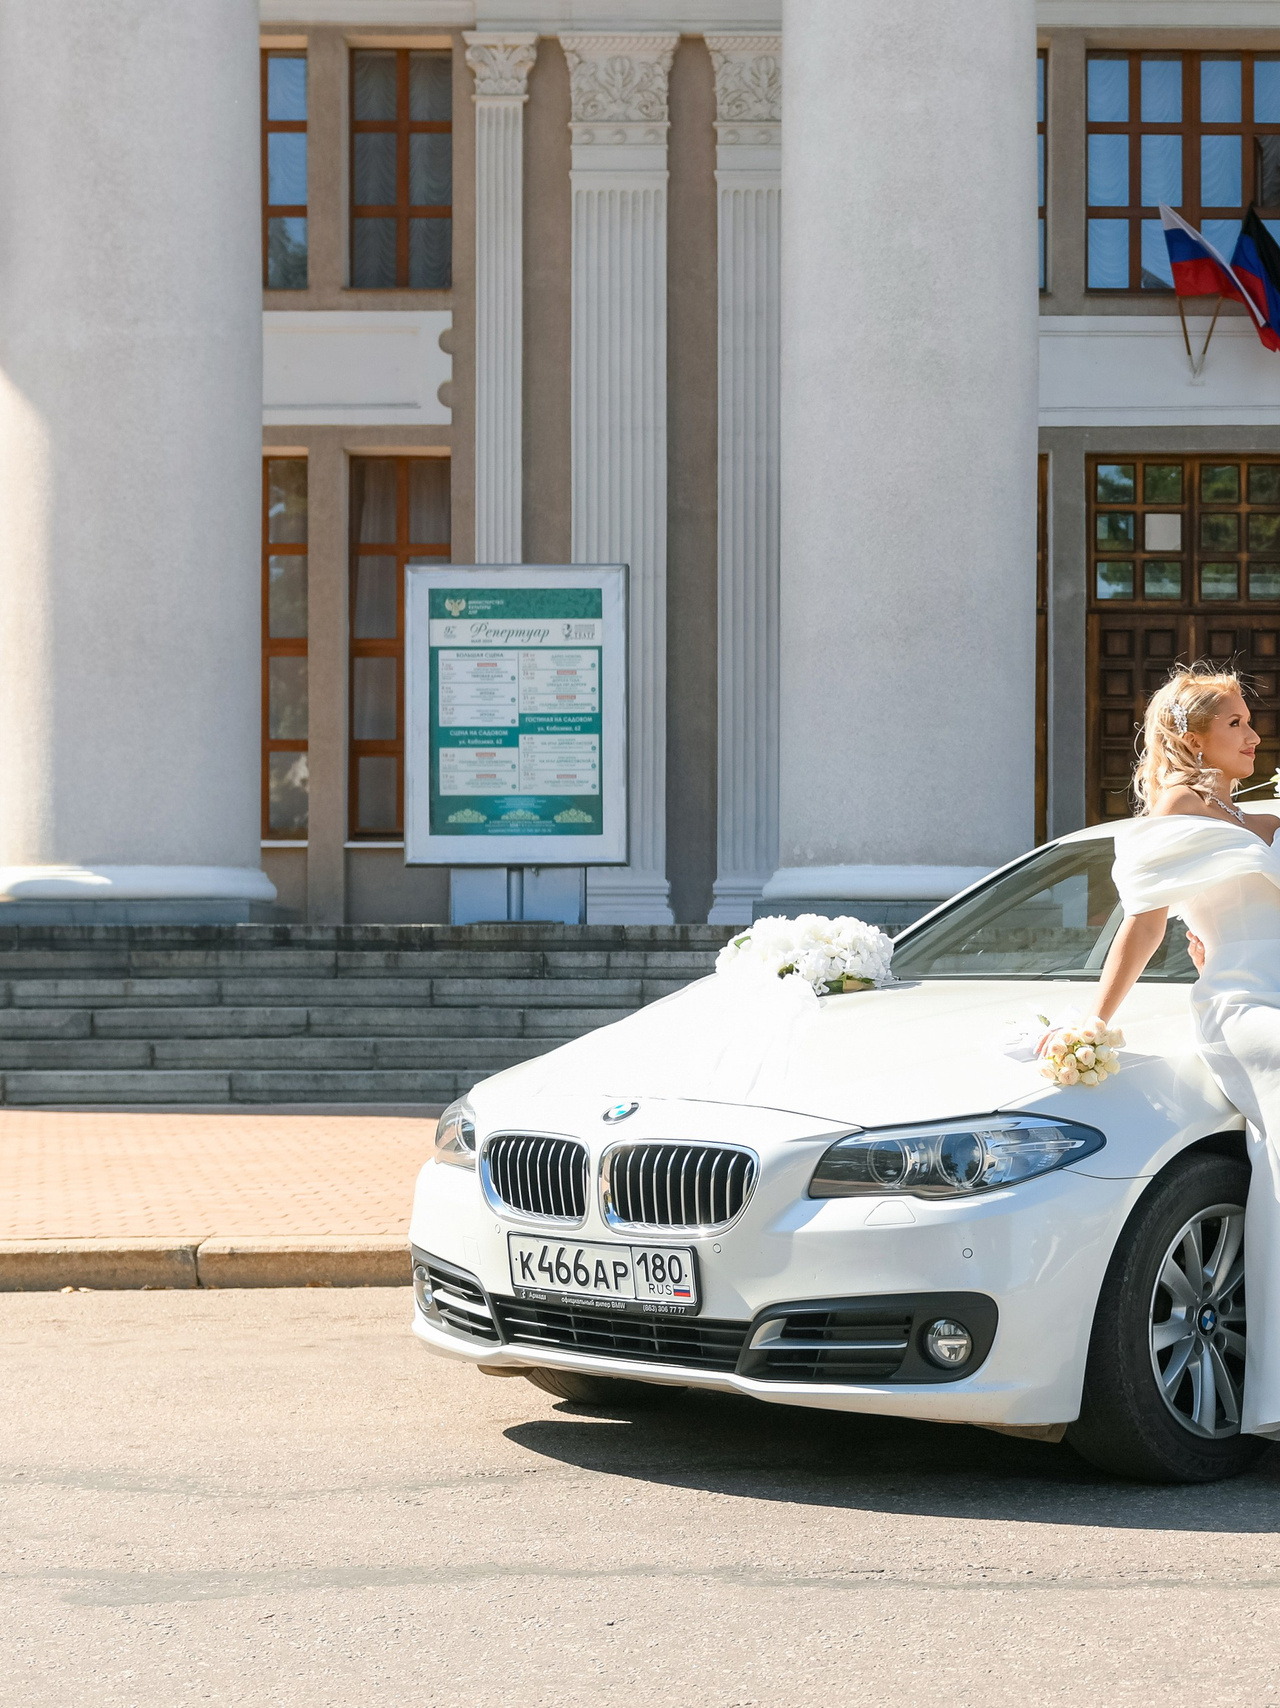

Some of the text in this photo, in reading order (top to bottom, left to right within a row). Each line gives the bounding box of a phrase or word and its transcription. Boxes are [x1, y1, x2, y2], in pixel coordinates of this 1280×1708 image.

[469, 622, 550, 643] Репертуар
[636, 1252, 682, 1284] 180
[648, 1283, 672, 1295] RUS
[561, 1296, 594, 1306] официальный
[595, 1301, 611, 1309] дилер
[611, 1301, 626, 1309] BMW
